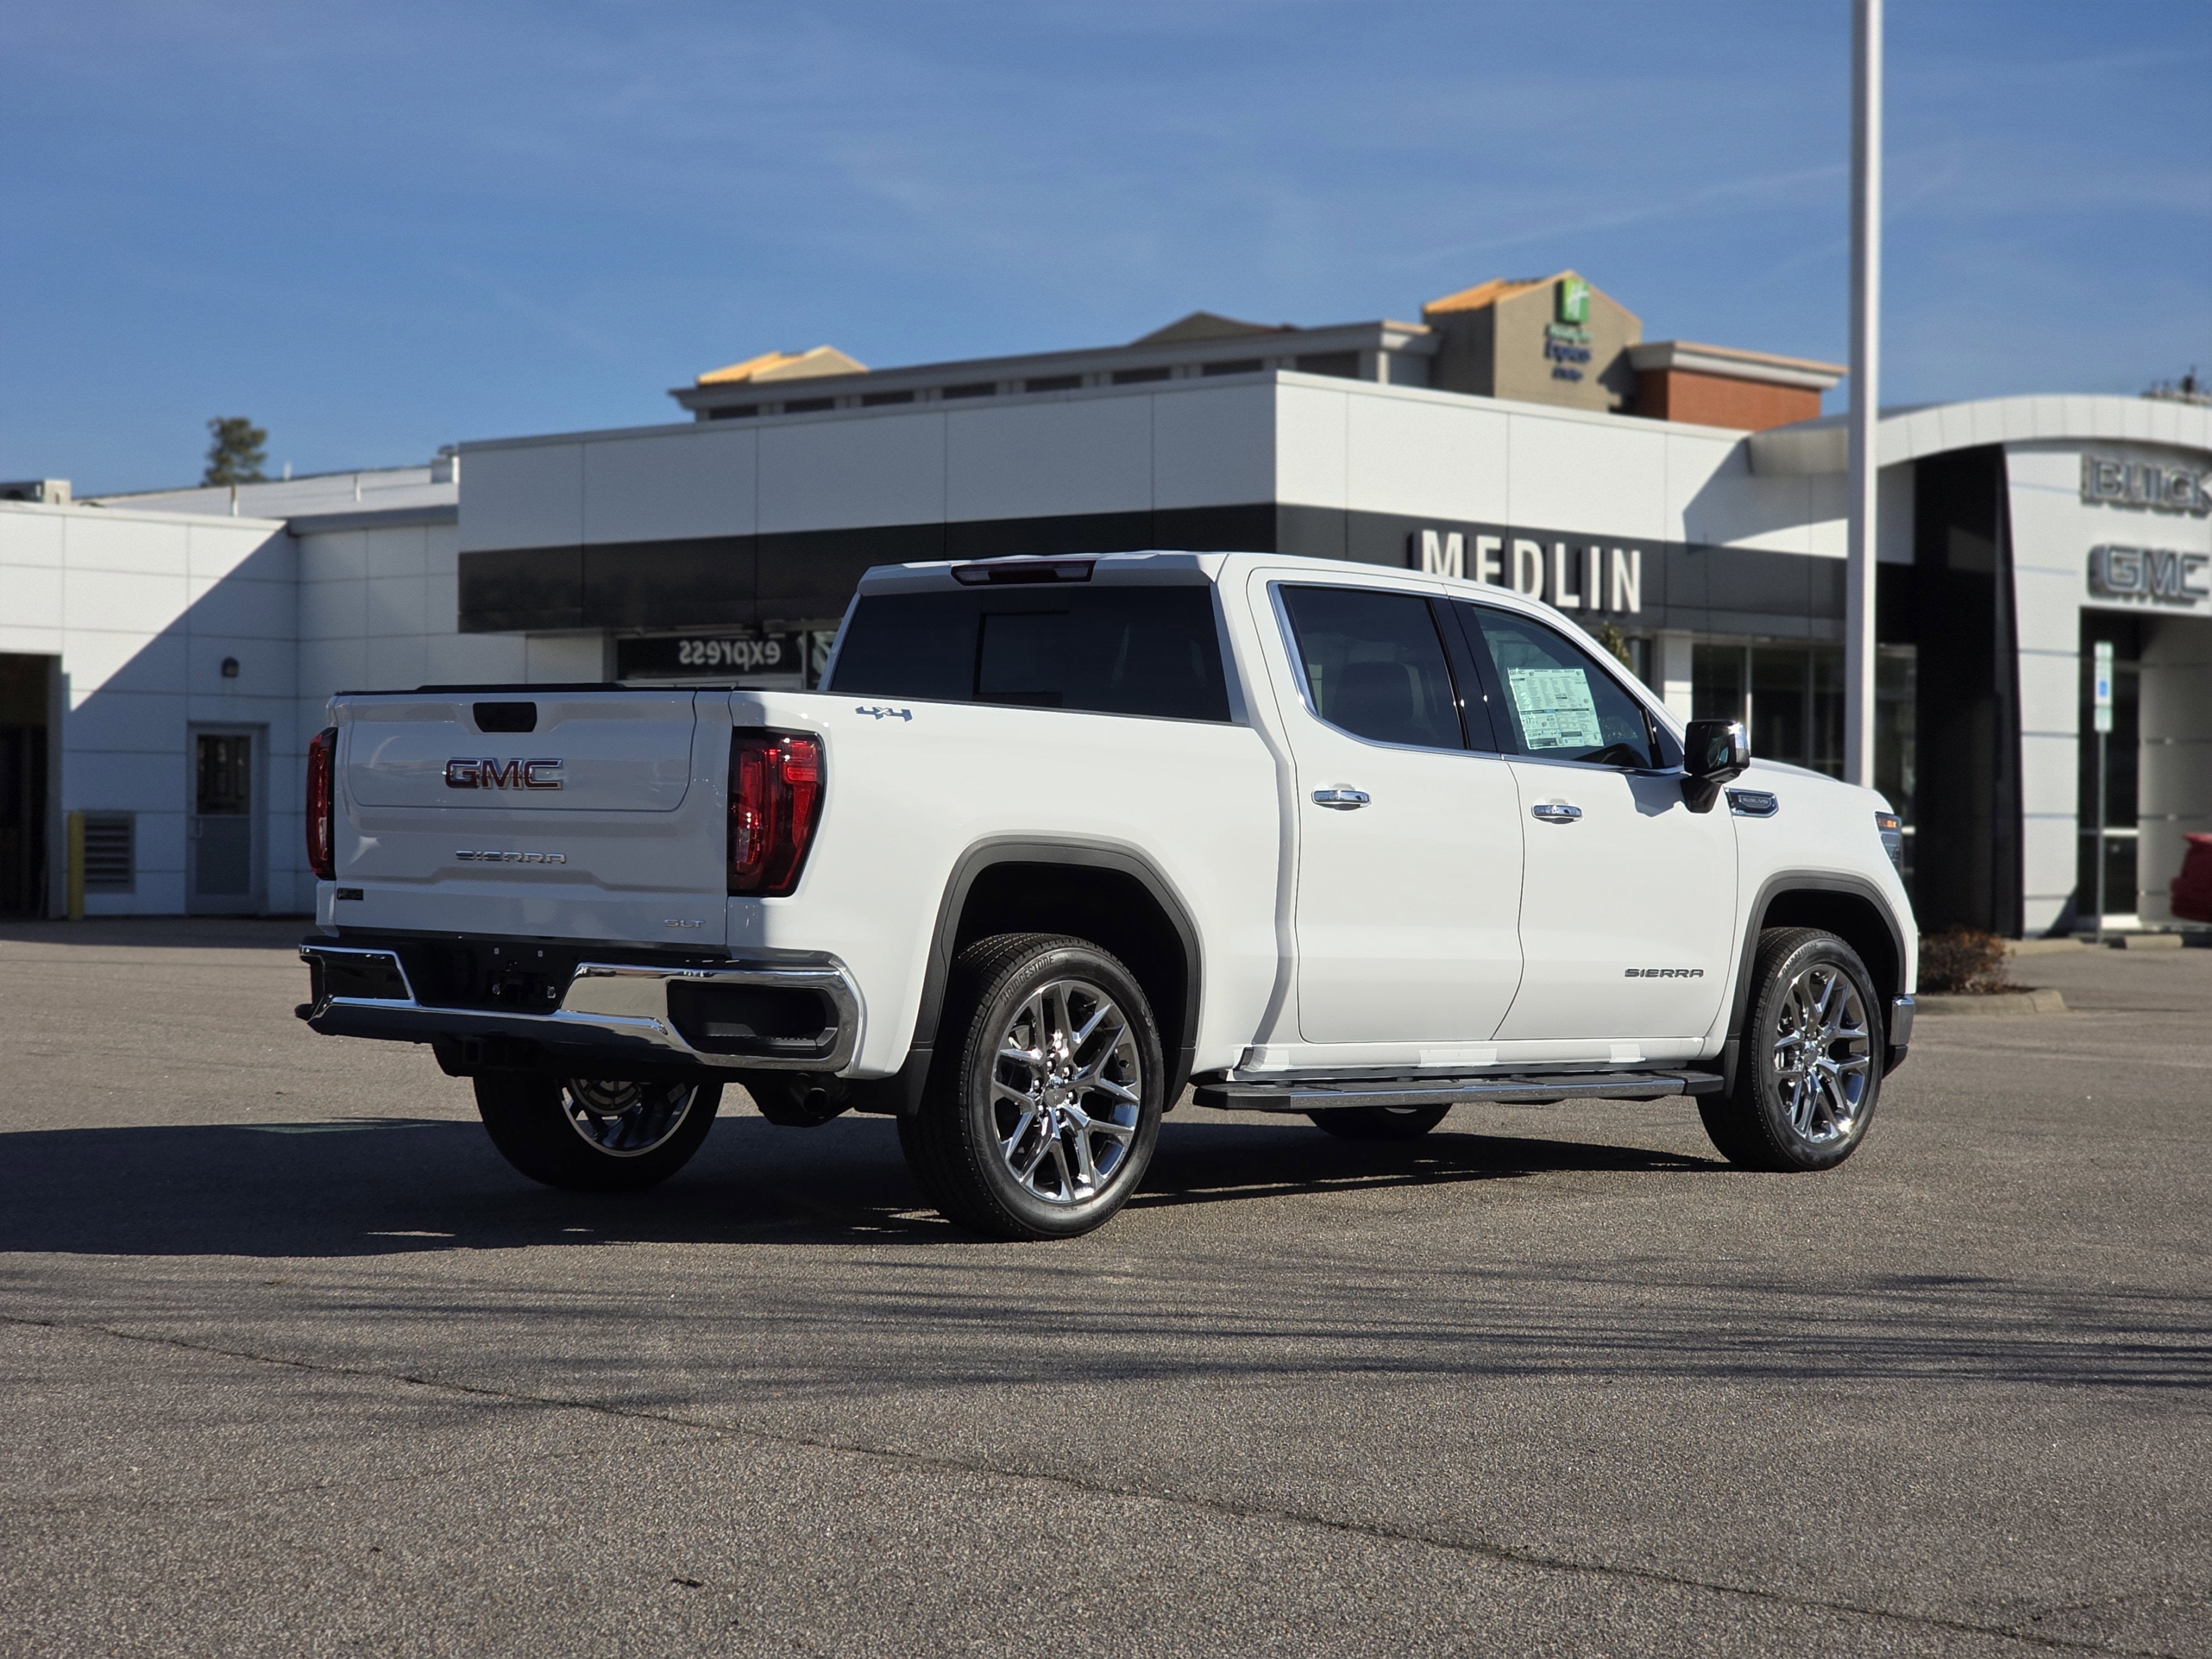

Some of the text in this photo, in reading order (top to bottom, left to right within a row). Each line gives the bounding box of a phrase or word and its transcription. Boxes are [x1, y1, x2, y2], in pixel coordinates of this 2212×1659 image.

[2090, 457, 2212, 511] BUICK
[1421, 529, 1641, 614] MEDLIN
[2104, 544, 2210, 601] GMC
[444, 757, 564, 790] GMC
[455, 850, 566, 864] SIERRA
[664, 919, 706, 928] SLT
[999, 954, 1055, 1008] BRIDGESTONE
[1624, 968, 1704, 978] SIERRA
